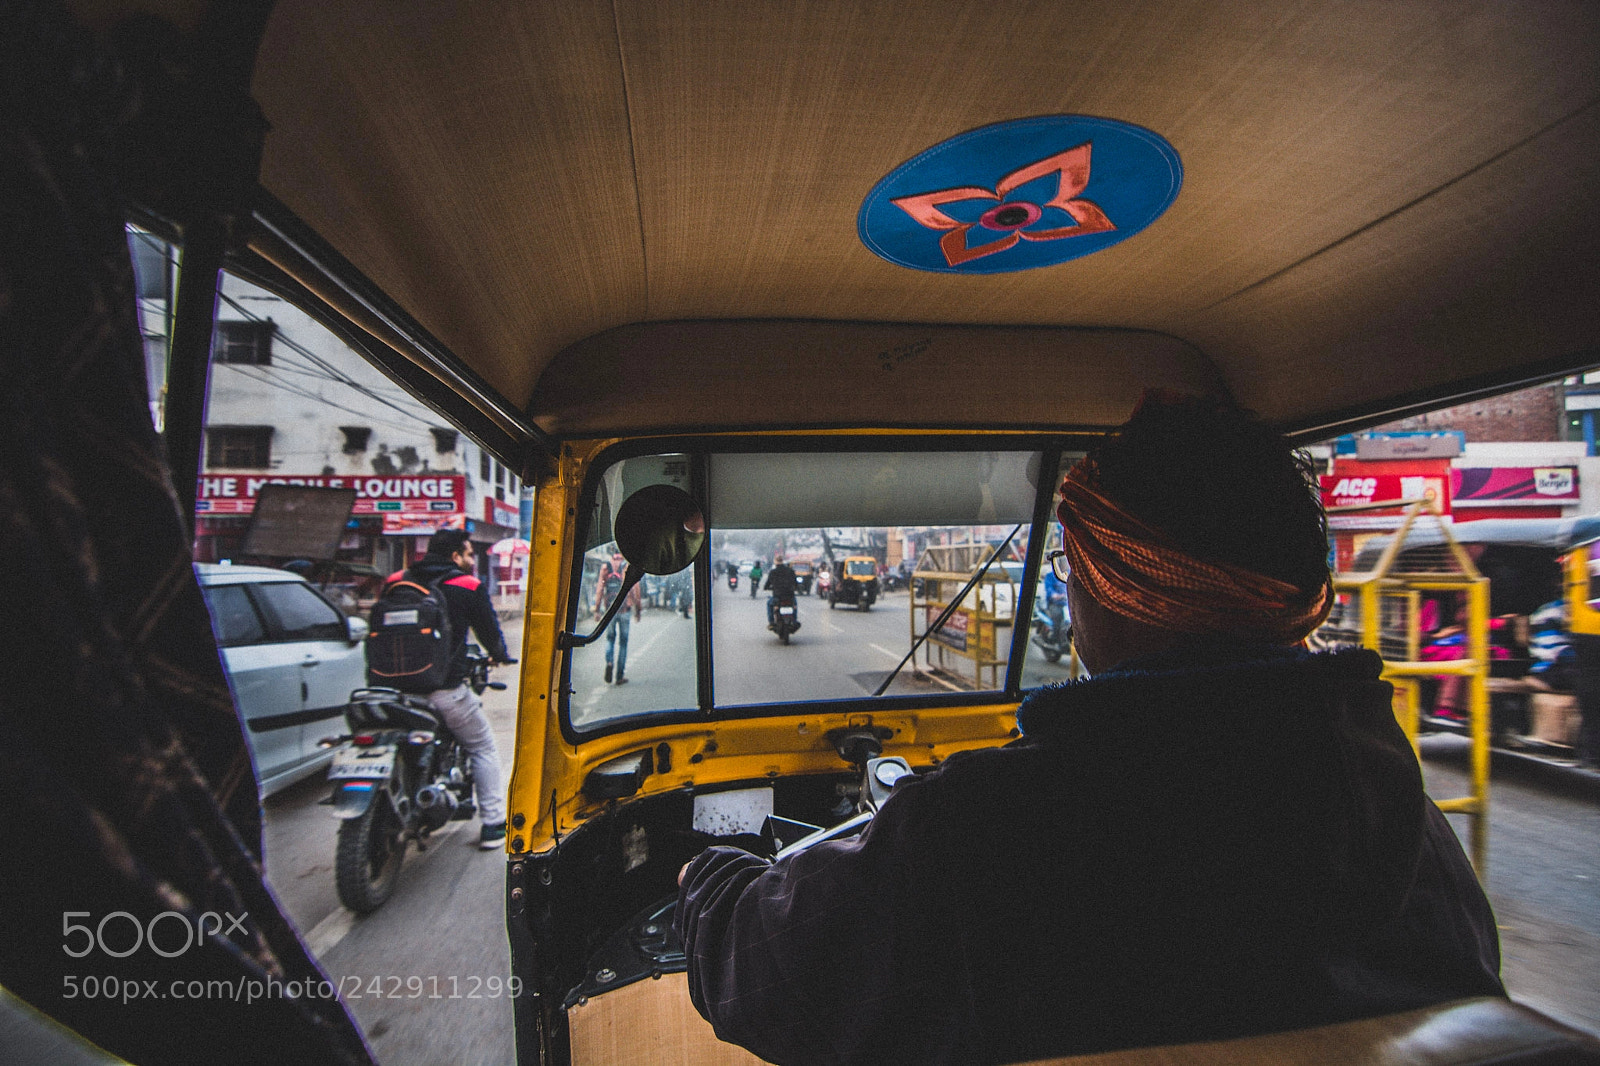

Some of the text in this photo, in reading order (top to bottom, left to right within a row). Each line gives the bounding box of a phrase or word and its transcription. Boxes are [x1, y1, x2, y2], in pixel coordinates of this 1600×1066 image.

[199, 478, 237, 498] HE
[354, 478, 454, 498] LOUNGE
[1331, 478, 1377, 497] ACC
